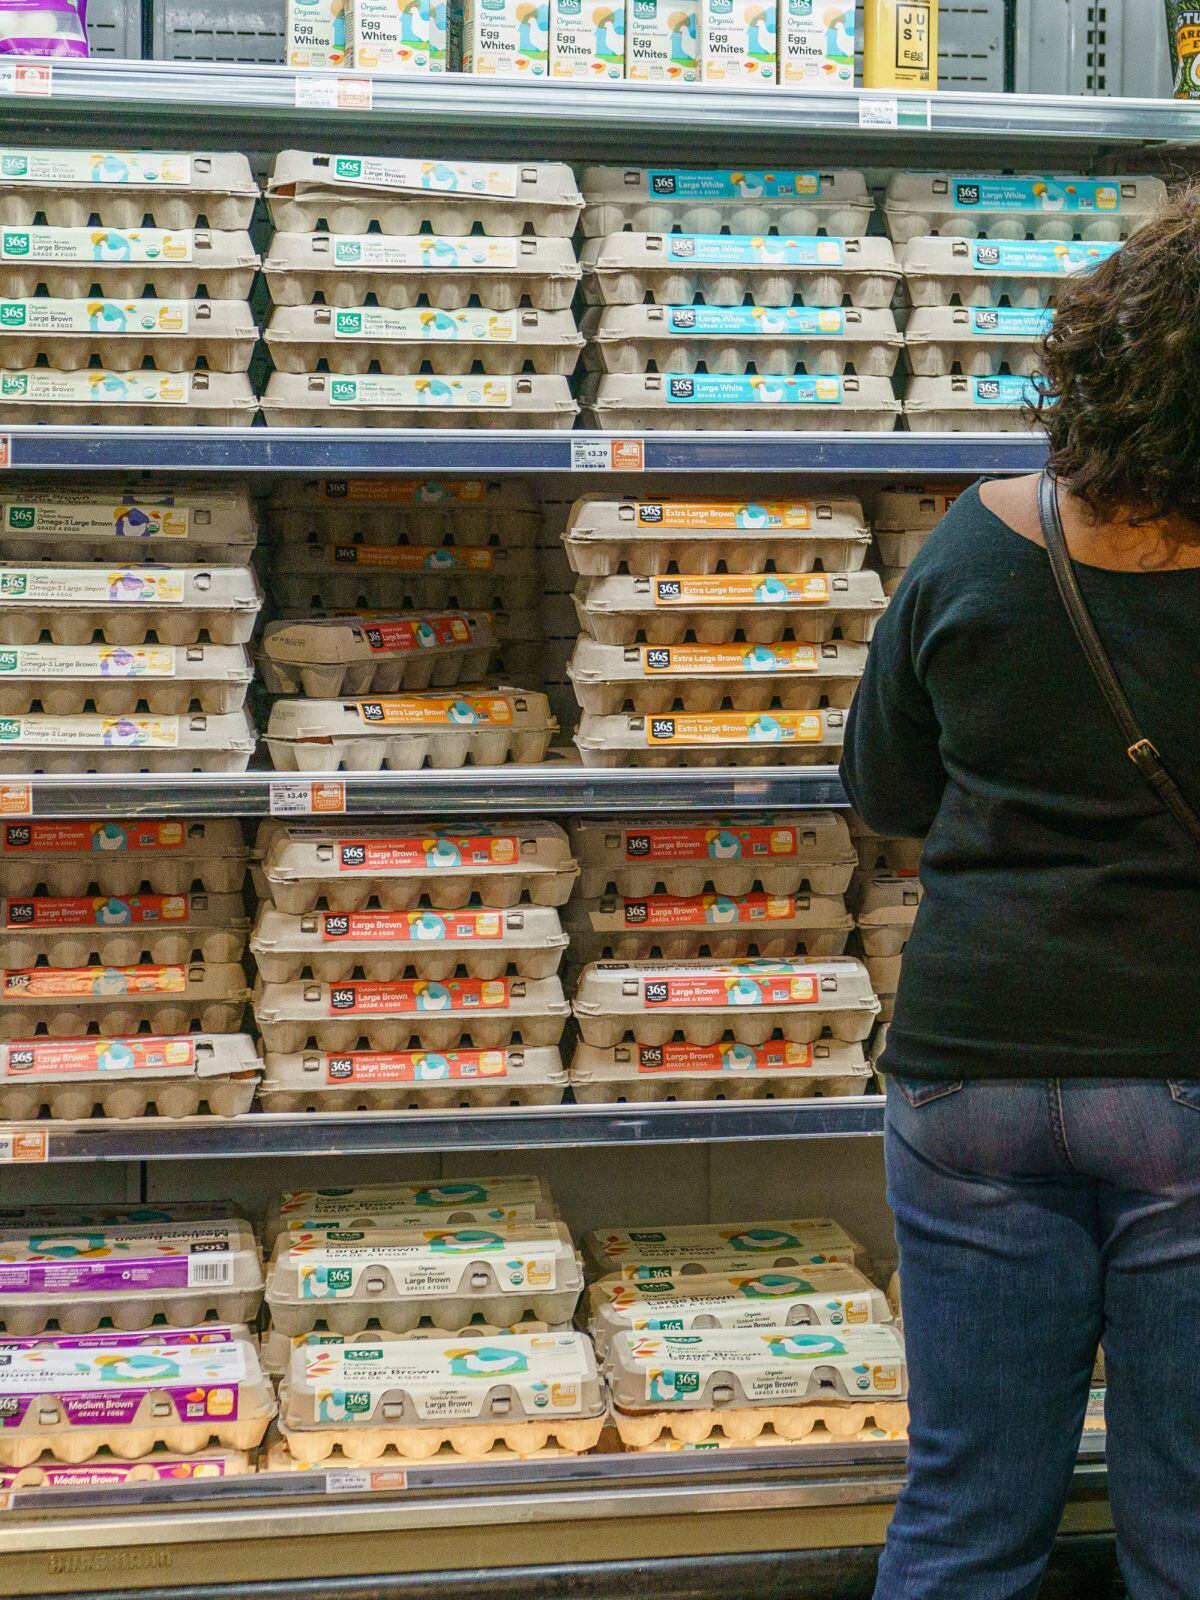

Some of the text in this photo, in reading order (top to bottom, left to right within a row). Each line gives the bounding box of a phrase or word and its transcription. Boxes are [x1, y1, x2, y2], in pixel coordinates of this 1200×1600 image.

[294, 24, 313, 35] Egg
[361, 19, 380, 30] Egg
[632, 22, 658, 30] Organic
[361, 31, 397, 41] Whites
[480, 29, 499, 39] Egg
[557, 33, 575, 44] Egg
[709, 32, 728, 43] Egg
[294, 36, 329, 46] Whites
[633, 38, 651, 48] Egg
[788, 34, 806, 45] Egg
[480, 40, 515, 51] Whites
[557, 45, 592, 55] Whites
[709, 44, 744, 54] Whites
[633, 49, 667, 59] Whites
[788, 46, 822, 56] Whites
[904, 50, 924, 61] Egg
[339, 161, 359, 171] 365
[364, 170, 383, 178] Large
[655, 179, 674, 188] 365
[678, 181, 700, 189] Large
[959, 188, 977, 197] 365
[6, 237, 27, 247] 365
[2, 307, 23, 318] 365
[29, 315, 49, 323] Large
[673, 381, 692, 391] 365
[697, 384, 718, 392] Large
[12, 510, 32, 522] 365
[70, 520, 90, 528] Large
[364, 705, 382, 715] 365
[386, 708, 445, 717] Extra Large Brown
[653, 721, 673, 732] 365
[677, 724, 747, 733] Extra Large Brown
[343, 847, 363, 858] 365
[368, 850, 390, 858] Large
[327, 918, 347, 928] 365
[352, 921, 374, 929] Large
[647, 985, 667, 996] 365
[672, 988, 692, 996] Large
[677, 1374, 696, 1385] 365
[752, 1382, 773, 1390] Large
[346, 1394, 368, 1405] 365
[69, 1400, 133, 1410] Medium Brown
